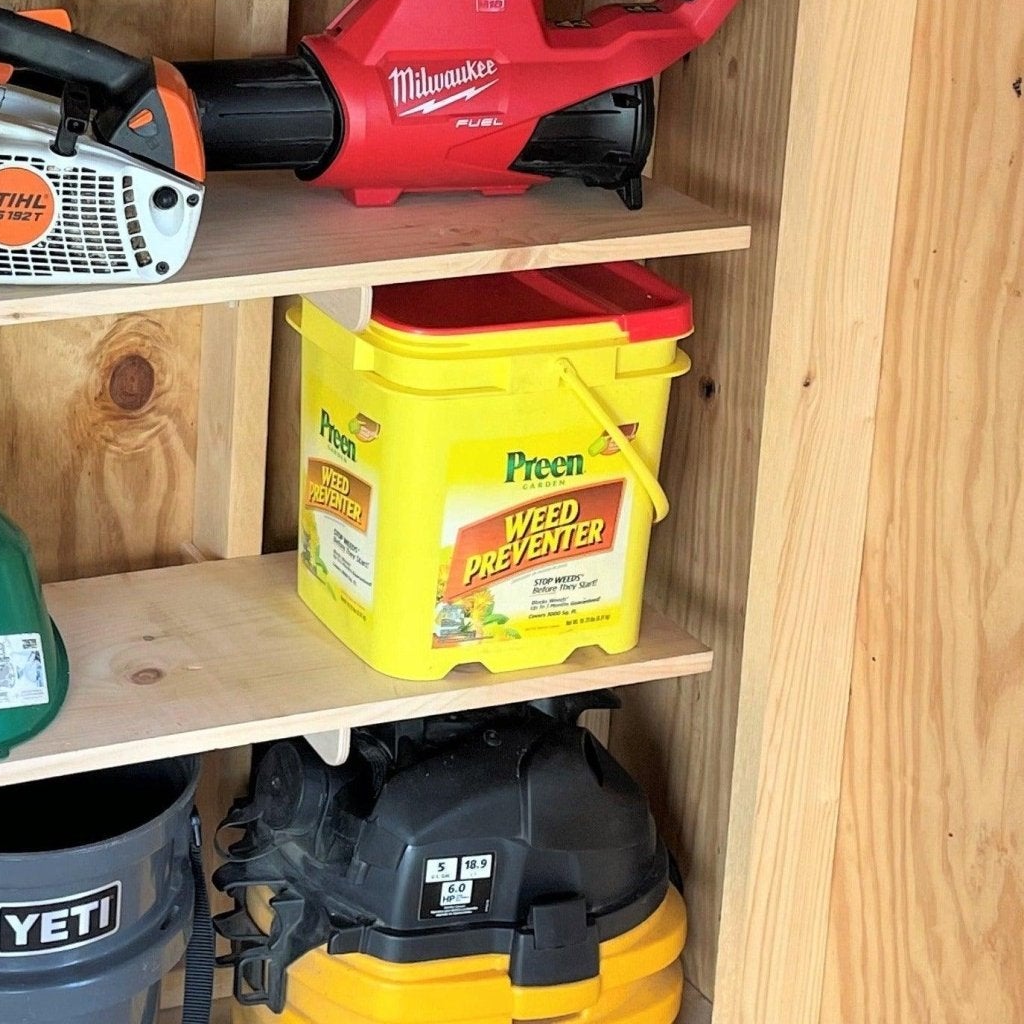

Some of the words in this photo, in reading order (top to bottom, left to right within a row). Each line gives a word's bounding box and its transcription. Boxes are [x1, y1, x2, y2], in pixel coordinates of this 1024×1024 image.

[388, 59, 498, 108] Milwaukee
[455, 117, 504, 129] FUEL
[7, 211, 32, 222] 192
[320, 408, 356, 463] Preen
[504, 451, 585, 484] Preen
[321, 465, 350, 497] WEED
[522, 480, 566, 490] GARDEN
[309, 481, 363, 526] PREVENTER
[504, 498, 581, 544] WEED
[463, 518, 605, 587] PREVENTER
[534, 577, 554, 586] STOP
[554, 574, 581, 584] WEEDS
[532, 585, 558, 594] Before
[559, 583, 577, 591] They
[438, 862, 446, 872] 5
[464, 858, 488, 870] 18.9
[448, 883, 466, 893] 6.0
[442, 895, 455, 904] HP
[4, 897, 111, 946] YETI
